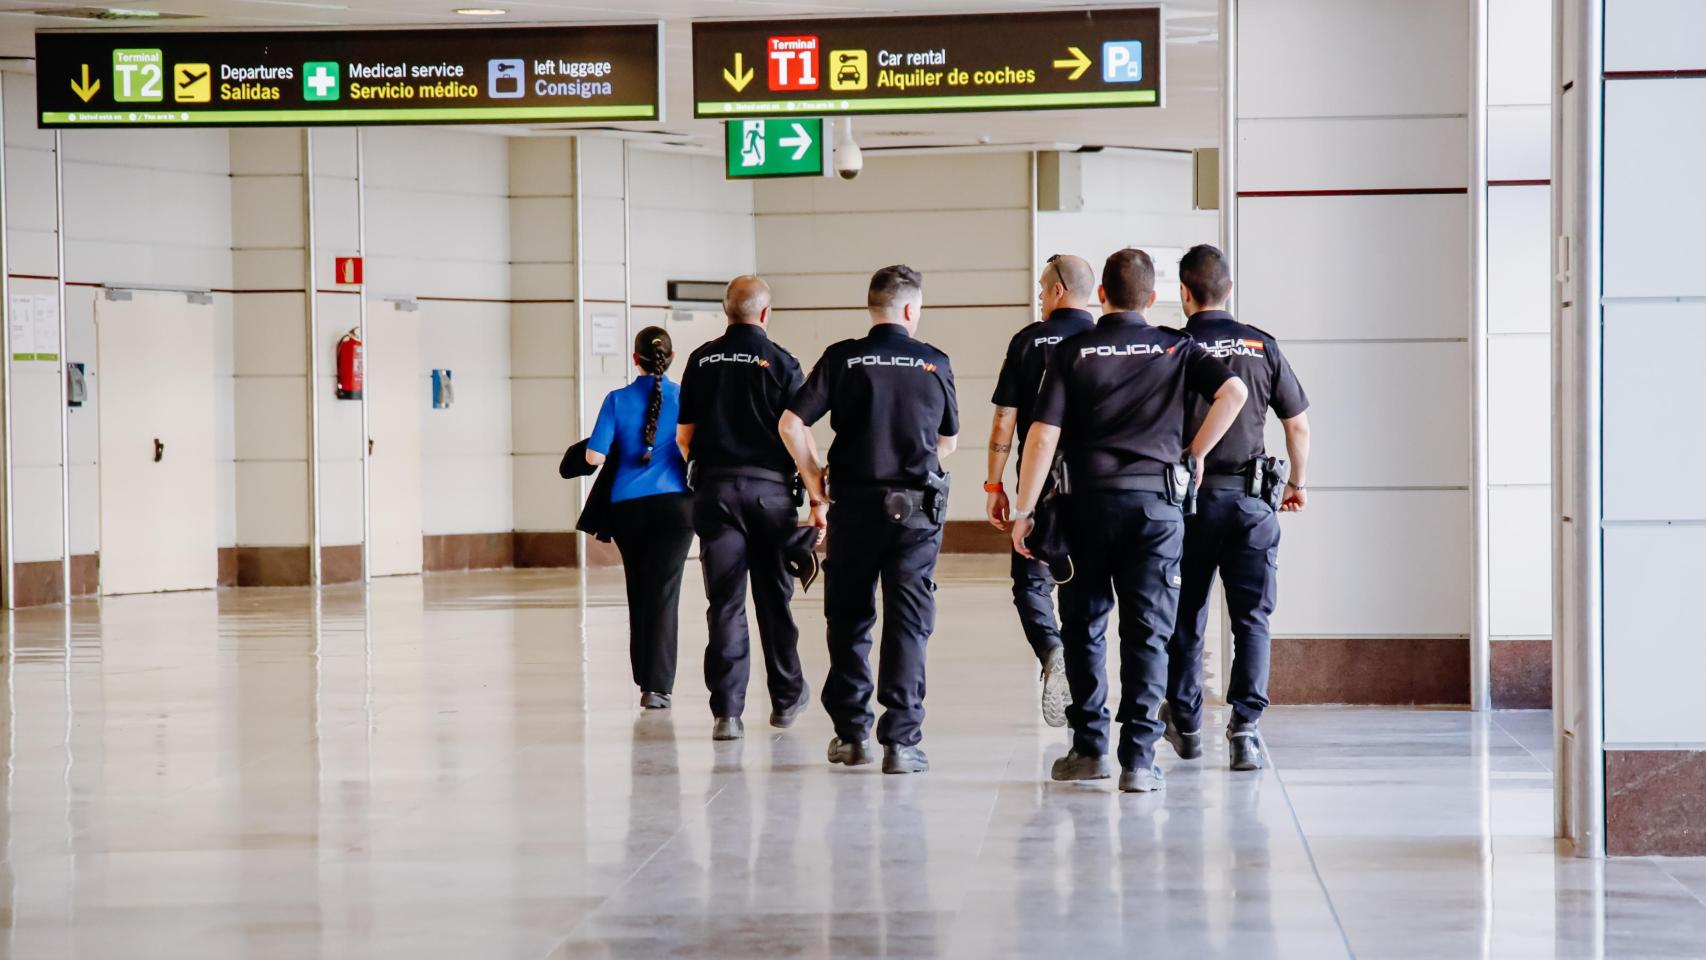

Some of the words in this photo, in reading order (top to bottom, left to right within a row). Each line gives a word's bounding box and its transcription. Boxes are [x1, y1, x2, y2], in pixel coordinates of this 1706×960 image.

[772, 39, 816, 50] Terminal
[117, 52, 159, 62] Terminal
[878, 50, 903, 67] Car
[907, 49, 945, 65] rental
[221, 64, 294, 82] Departures
[349, 63, 407, 78] Medical
[411, 62, 464, 77] service
[534, 60, 556, 75] left
[559, 59, 611, 77] luggage
[770, 51, 816, 85] T1
[115, 64, 161, 97] T2
[877, 69, 943, 90] Alquiler
[947, 68, 969, 85] de
[973, 66, 1036, 85] coches
[221, 83, 280, 100] Salidas
[351, 82, 414, 99] Servicio
[419, 81, 478, 98] médico
[535, 79, 612, 98] Consigna
[1034, 336, 1063, 347] PO
[1080, 344, 1164, 358] POLICIA
[699, 353, 760, 367] POLICIA
[847, 355, 926, 369] POLICIA
